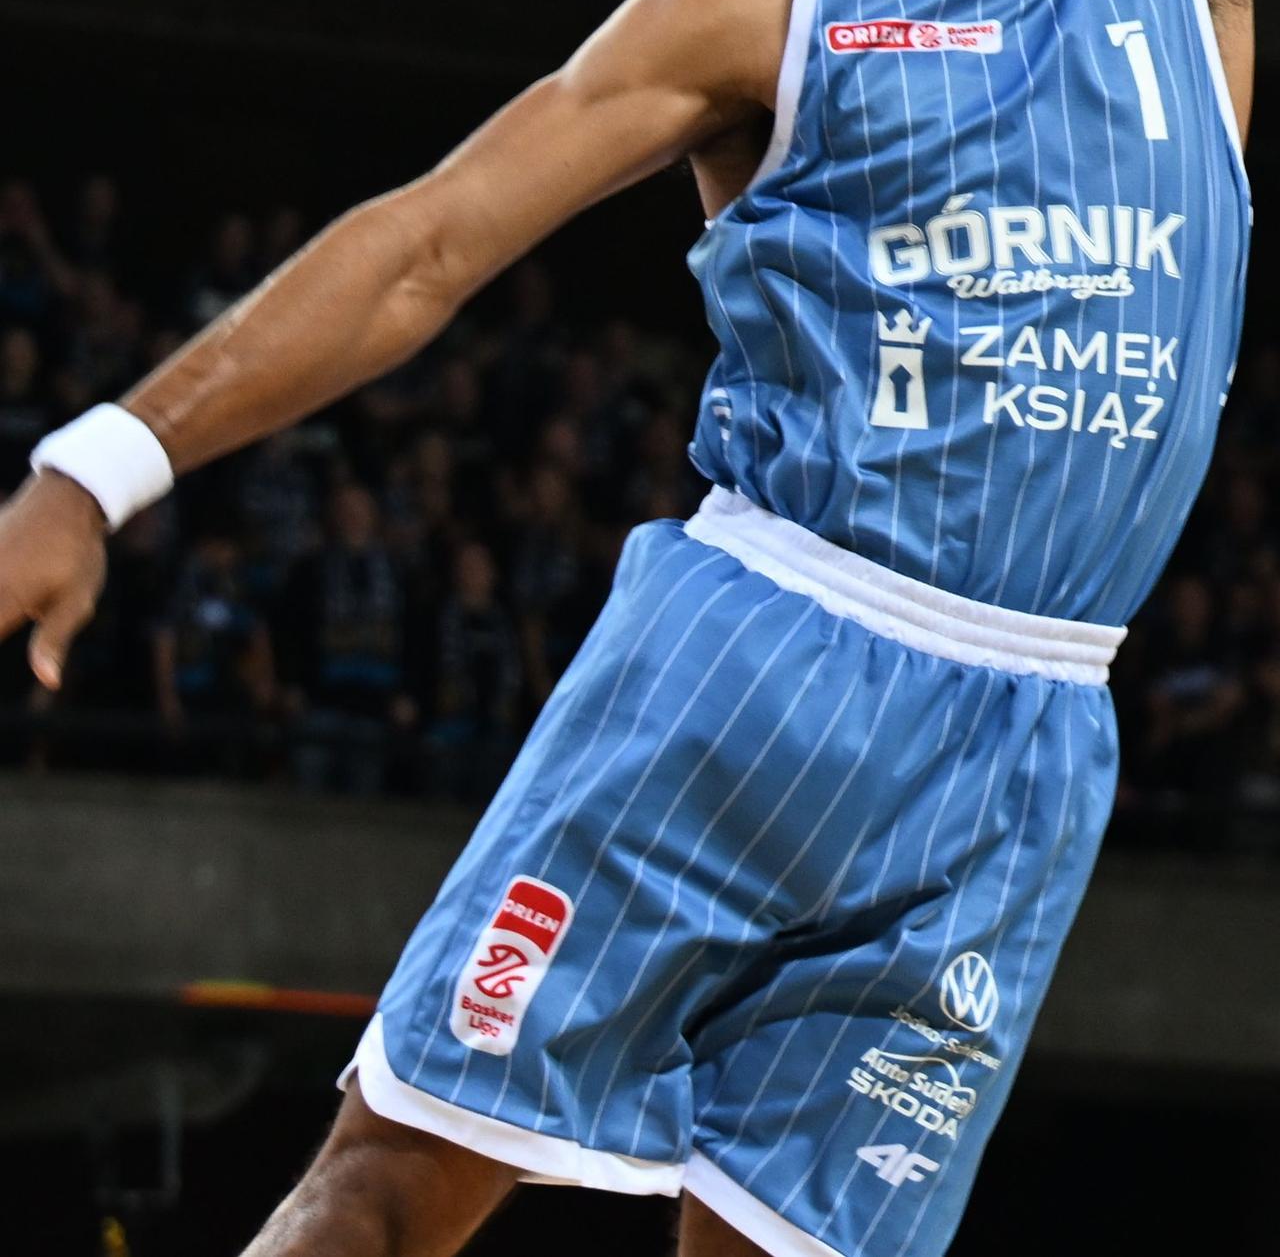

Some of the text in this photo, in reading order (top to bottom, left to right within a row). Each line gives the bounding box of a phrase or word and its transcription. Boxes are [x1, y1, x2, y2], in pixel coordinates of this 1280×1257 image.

[834, 26, 905, 46] ORLEN
[1106, 20, 1169, 140] 1
[868, 193, 1187, 287] GÓRNIK
[958, 325, 1179, 381] ZAMEK
[982, 381, 1165, 449] KSIĄŻ
[502, 899, 561, 933] ORLEN
[461, 995, 514, 1027] Basket
[469, 1015, 500, 1037] Liga
[860, 1047, 910, 1083] Auto
[856, 1144, 941, 1188] 4F
